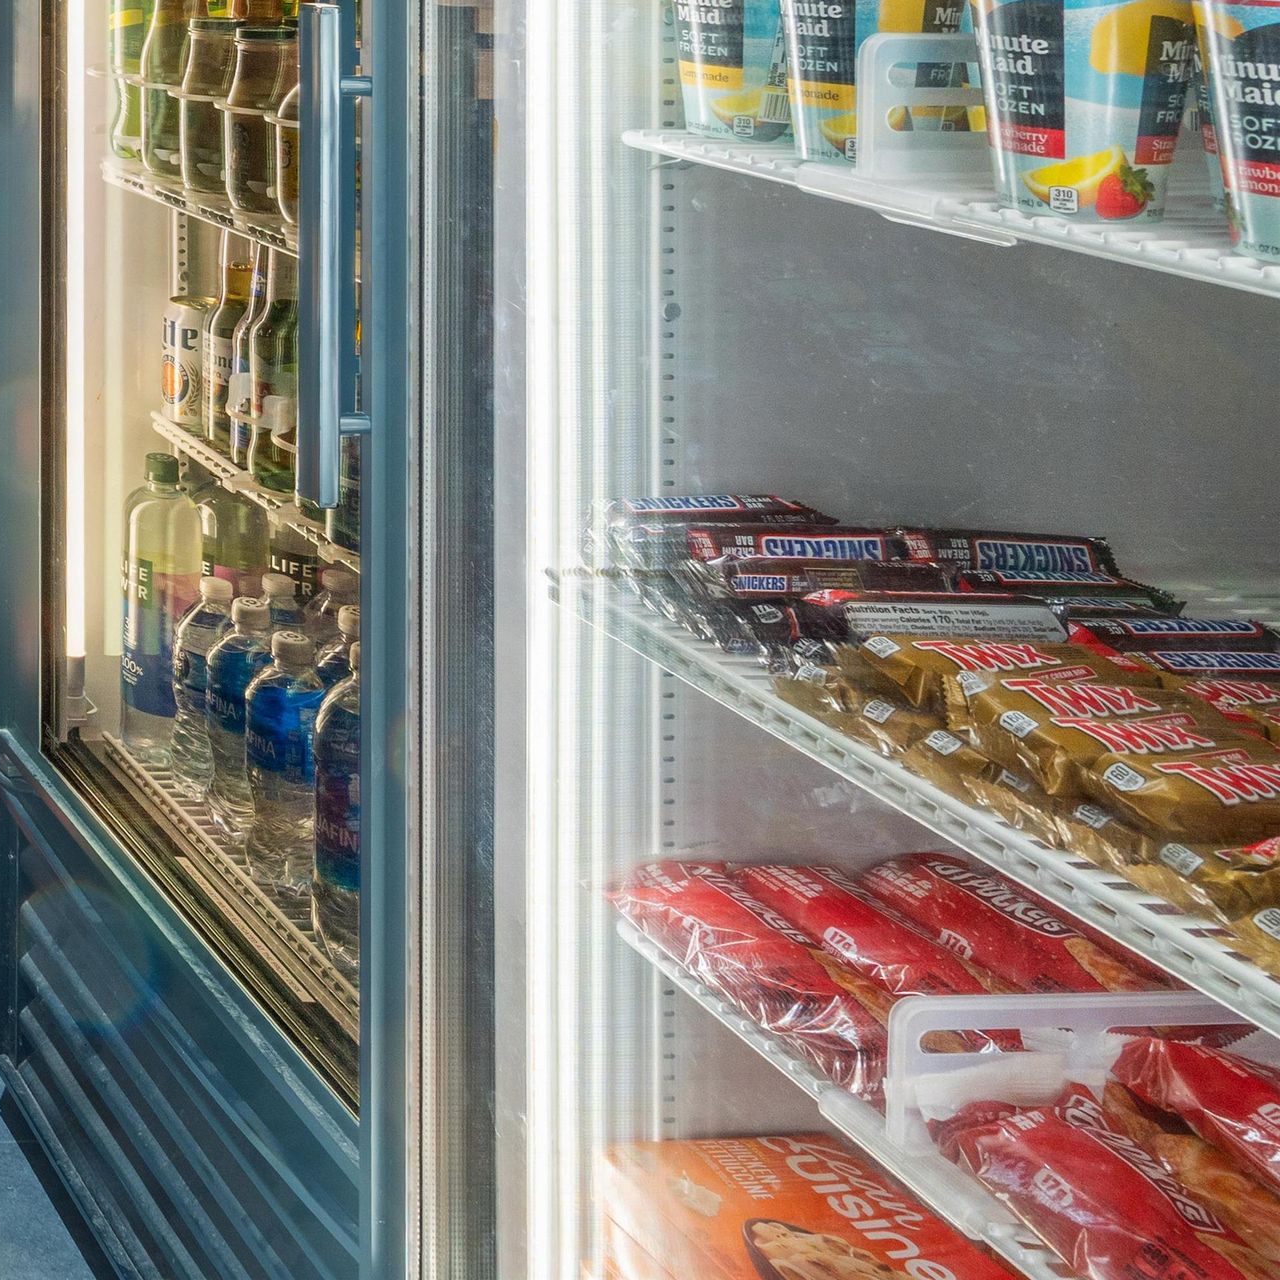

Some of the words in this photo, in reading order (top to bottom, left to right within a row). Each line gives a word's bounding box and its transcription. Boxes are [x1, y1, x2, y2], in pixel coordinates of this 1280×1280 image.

[677, 4, 721, 25] Maid
[681, 30, 720, 43] SOFT
[679, 41, 729, 58] FROZEN
[1054, 188, 1074, 199] 310
[938, 548, 970, 559] CREAM
[978, 540, 1092, 573] SNICKERS
[270, 554, 313, 579] LIFE
[734, 575, 787, 592] SNICKERS
[846, 604, 888, 615] Nutrition
[891, 605, 921, 615] Facts
[914, 639, 1063, 672] TWIX
[1003, 676, 1162, 719] TWIX
[1002, 711, 1023, 726] 160
[1052, 716, 1217, 755] TWIX
[1106, 763, 1131, 783] 160
[1161, 843, 1183, 863] 160
[700, 1140, 773, 1203] FETTUCCINE
[718, 1140, 775, 1185] CHICKEN
[786, 1154, 957, 1280] Cuisine
